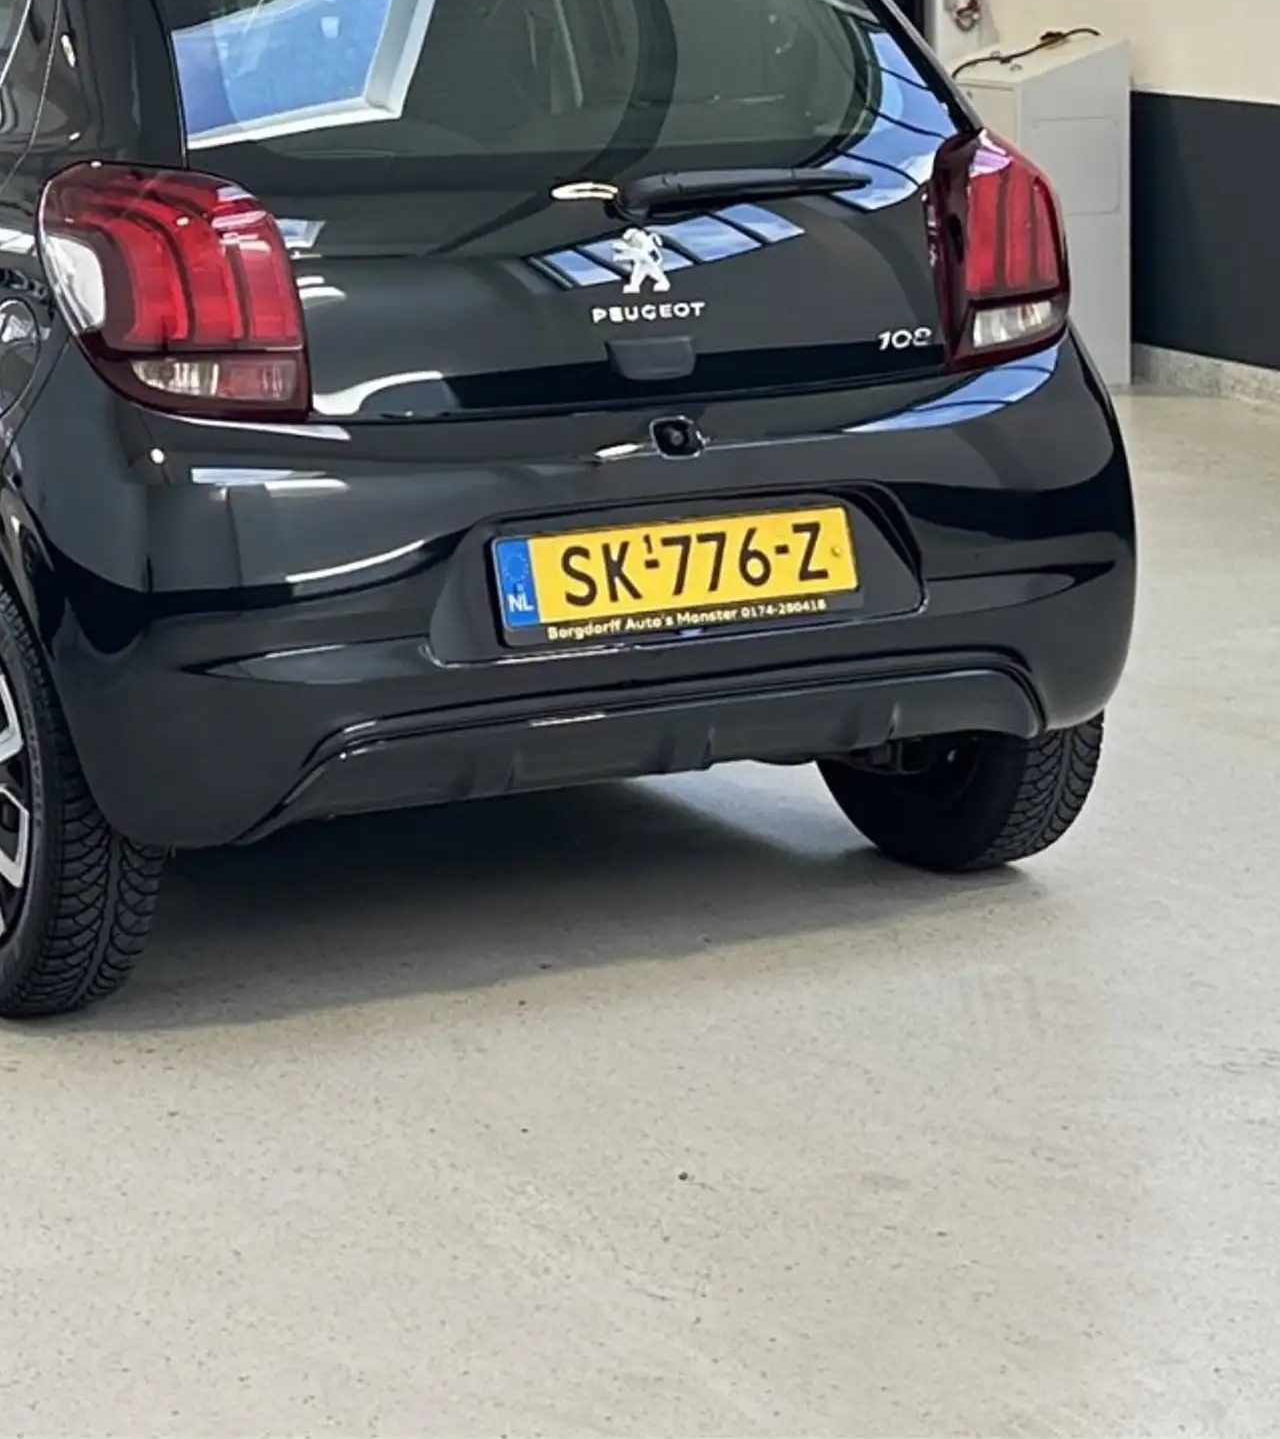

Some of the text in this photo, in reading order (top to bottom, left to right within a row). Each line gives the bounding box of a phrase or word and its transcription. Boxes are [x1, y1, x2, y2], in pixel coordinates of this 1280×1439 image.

[591, 301, 707, 324] PEUGEOT
[877, 326, 932, 351] 108
[506, 592, 534, 613] NL
